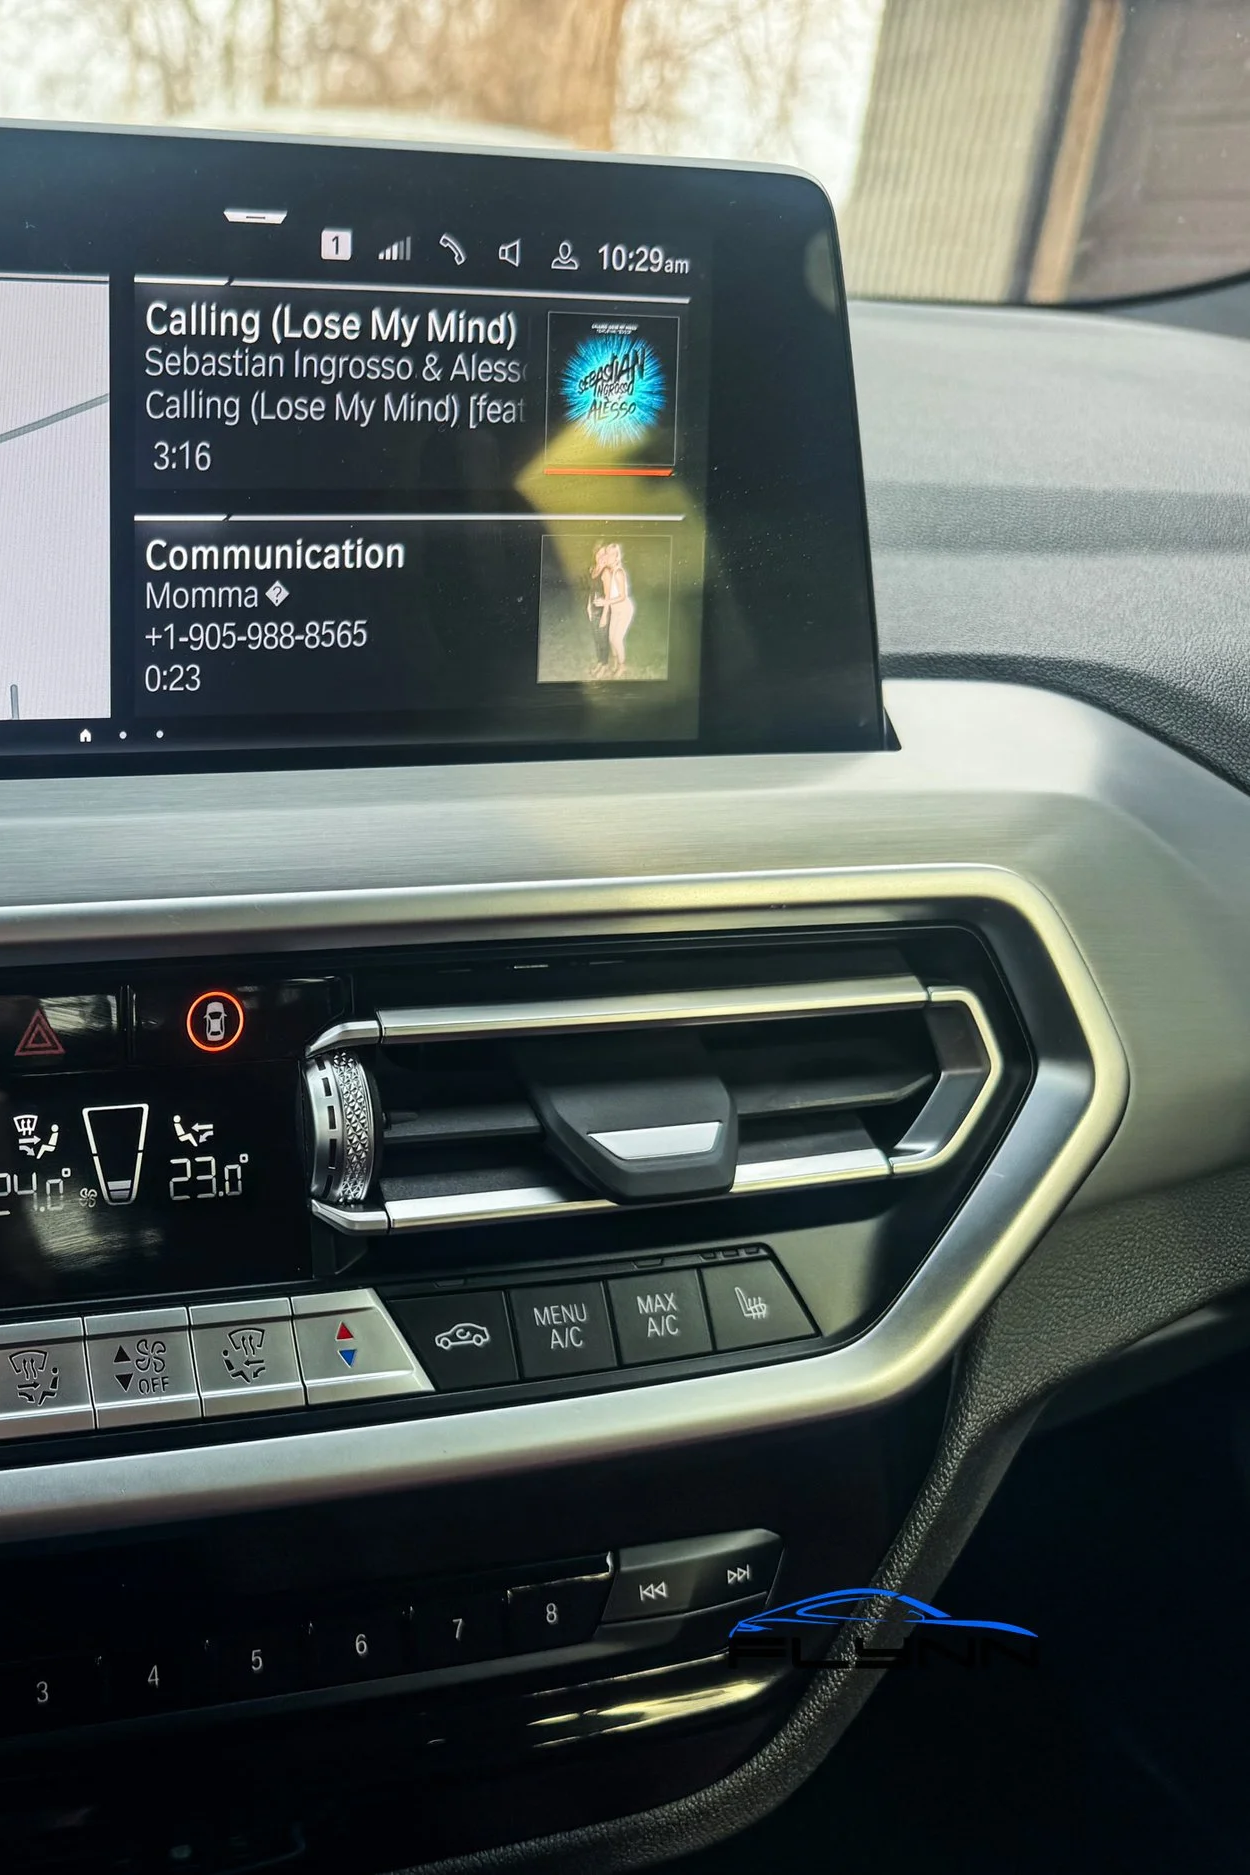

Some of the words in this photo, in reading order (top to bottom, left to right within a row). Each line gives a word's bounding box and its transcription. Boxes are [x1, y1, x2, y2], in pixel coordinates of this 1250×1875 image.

[146, 302, 260, 343] Calling
[271, 304, 361, 343] (Lose
[370, 308, 418, 346] My
[427, 308, 517, 350] Mind)
[145, 345, 283, 379] Sebastian
[294, 349, 414, 384] Ingrosso
[422, 354, 443, 380] &
[146, 389, 241, 423] Calling
[250, 390, 326, 425] (Lose
[334, 392, 375, 427] My
[384, 393, 459, 429] Mind)
[469, 394, 526, 429] [feat
[153, 440, 212, 472] 3:16
[146, 537, 406, 572] Communication
[146, 582, 259, 610] Momma
[145, 619, 368, 652] +1-905-988-8565
[145, 663, 202, 693] 0:23
[533, 1303, 588, 1327] MENU
[636, 1293, 677, 1314] MAX
[550, 1326, 584, 1351] A/C
[646, 1314, 679, 1338] A/C
[138, 1375, 170, 1396] OFF
[545, 1602, 558, 1625] 8
[452, 1618, 464, 1641] 7
[355, 1633, 368, 1657] 6
[251, 1649, 263, 1673] 5
[147, 1664, 160, 1689] 4
[36, 1680, 49, 1703] 3
